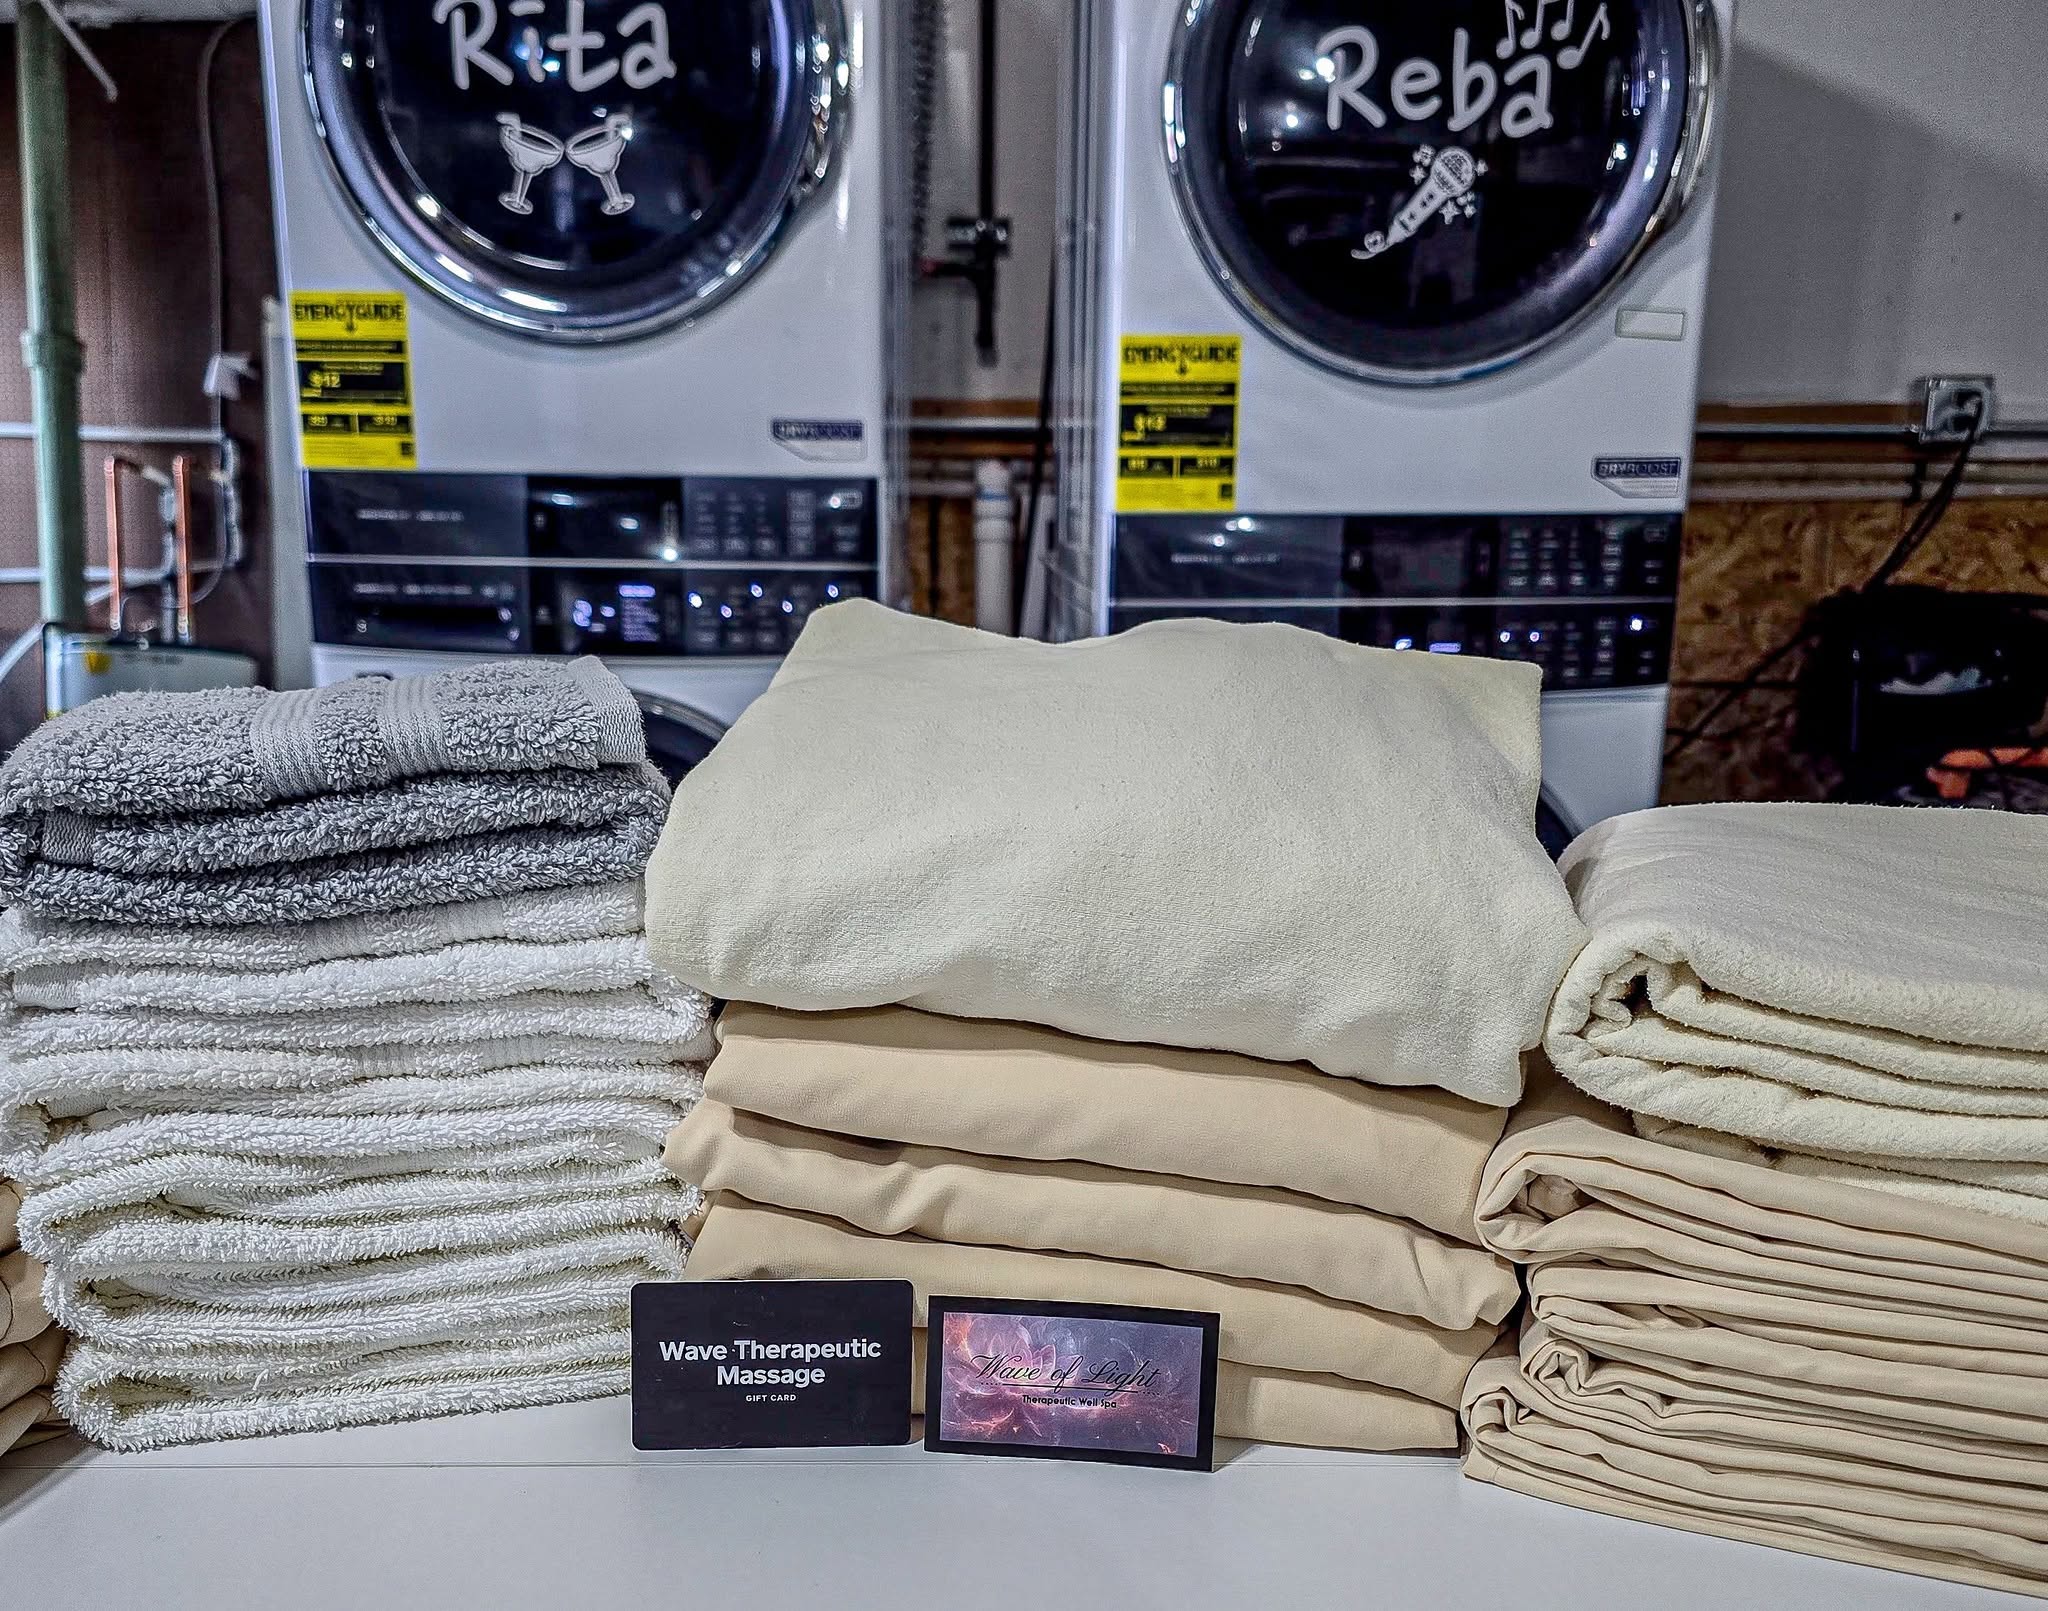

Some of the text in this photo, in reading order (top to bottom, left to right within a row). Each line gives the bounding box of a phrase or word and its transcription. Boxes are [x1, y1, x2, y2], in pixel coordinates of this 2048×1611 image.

[432, 0, 677, 92] Rita
[1316, 25, 1554, 138] Reba
[659, 1338, 882, 1363] Wave Therapeutic
[717, 1365, 826, 1388] Massage
[970, 1353, 1162, 1396] Wave of Light
[745, 1394, 797, 1402] GIFT CARD
[1023, 1394, 1117, 1410] Therapeutic Well Spa
